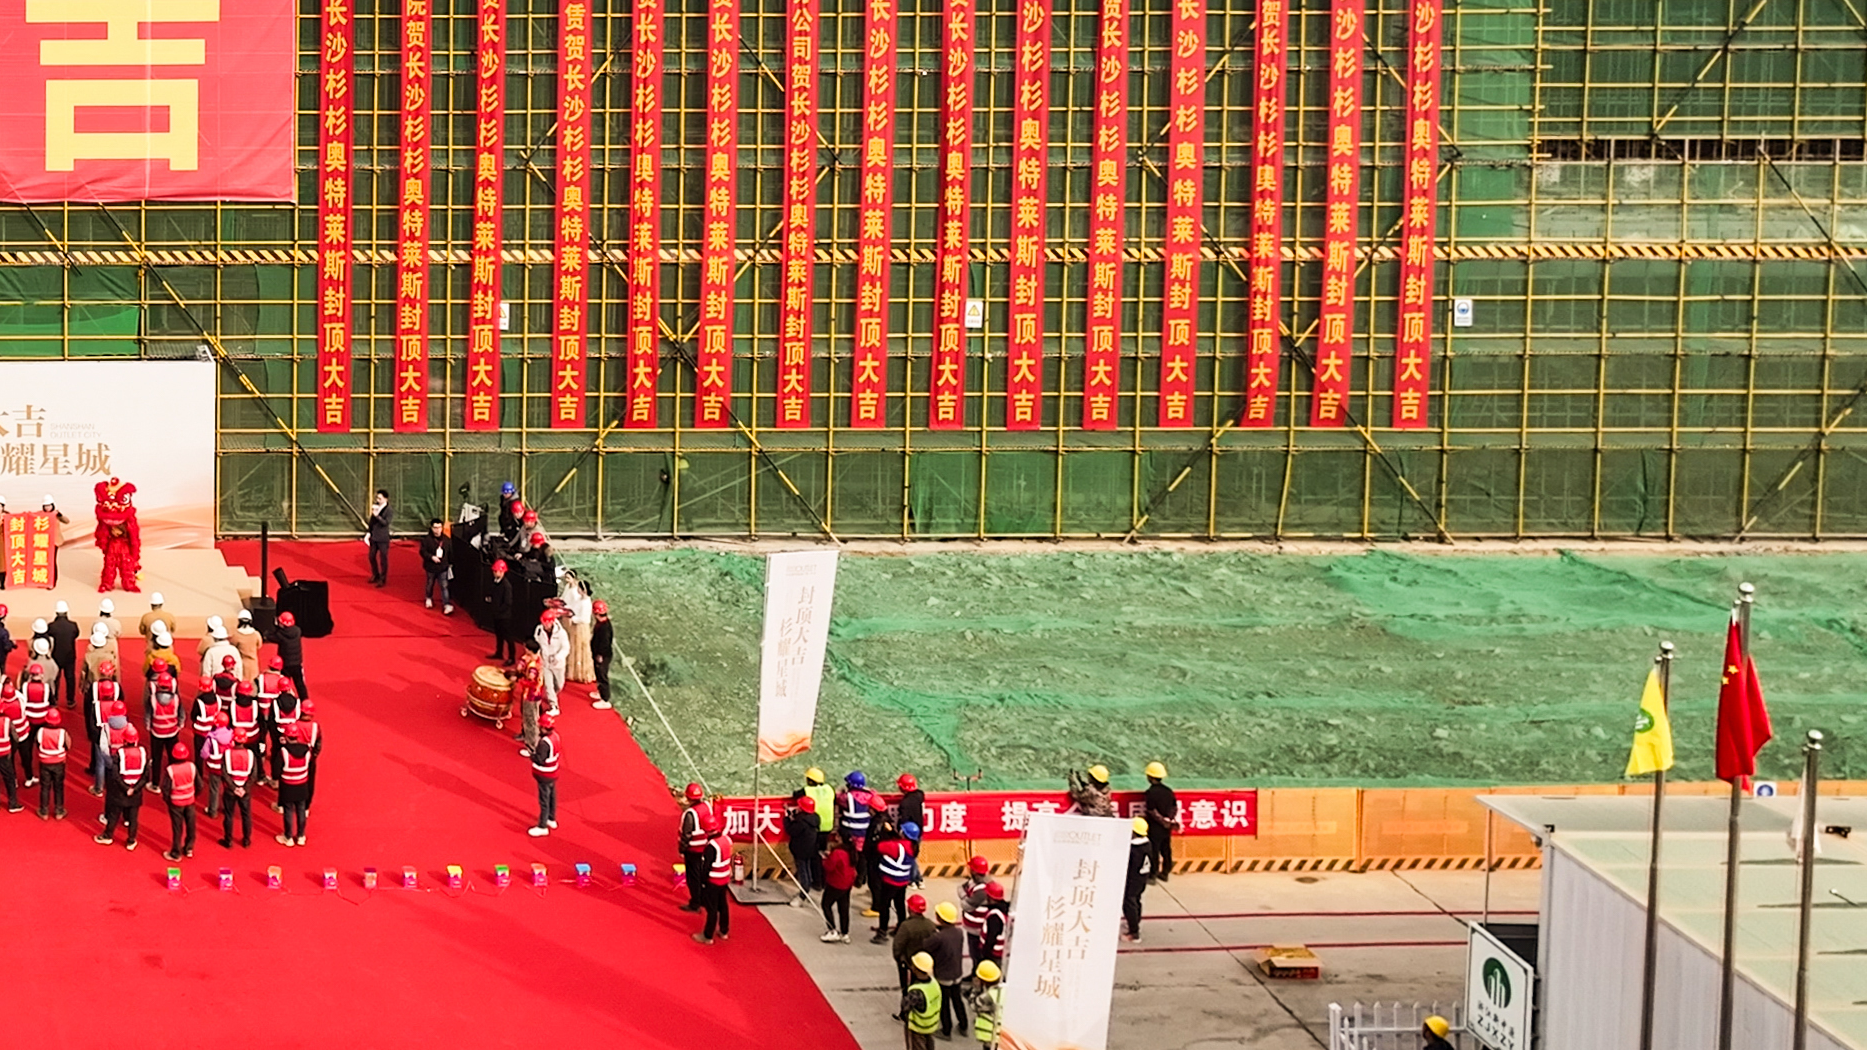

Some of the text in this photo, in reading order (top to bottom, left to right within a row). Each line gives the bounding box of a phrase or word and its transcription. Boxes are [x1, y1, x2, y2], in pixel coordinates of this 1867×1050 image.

[791, 586, 815, 666] 封顶大吉
[1034, 895, 1066, 1000] 杉耀星城
[1067, 858, 1100, 961] 封顶大吉
